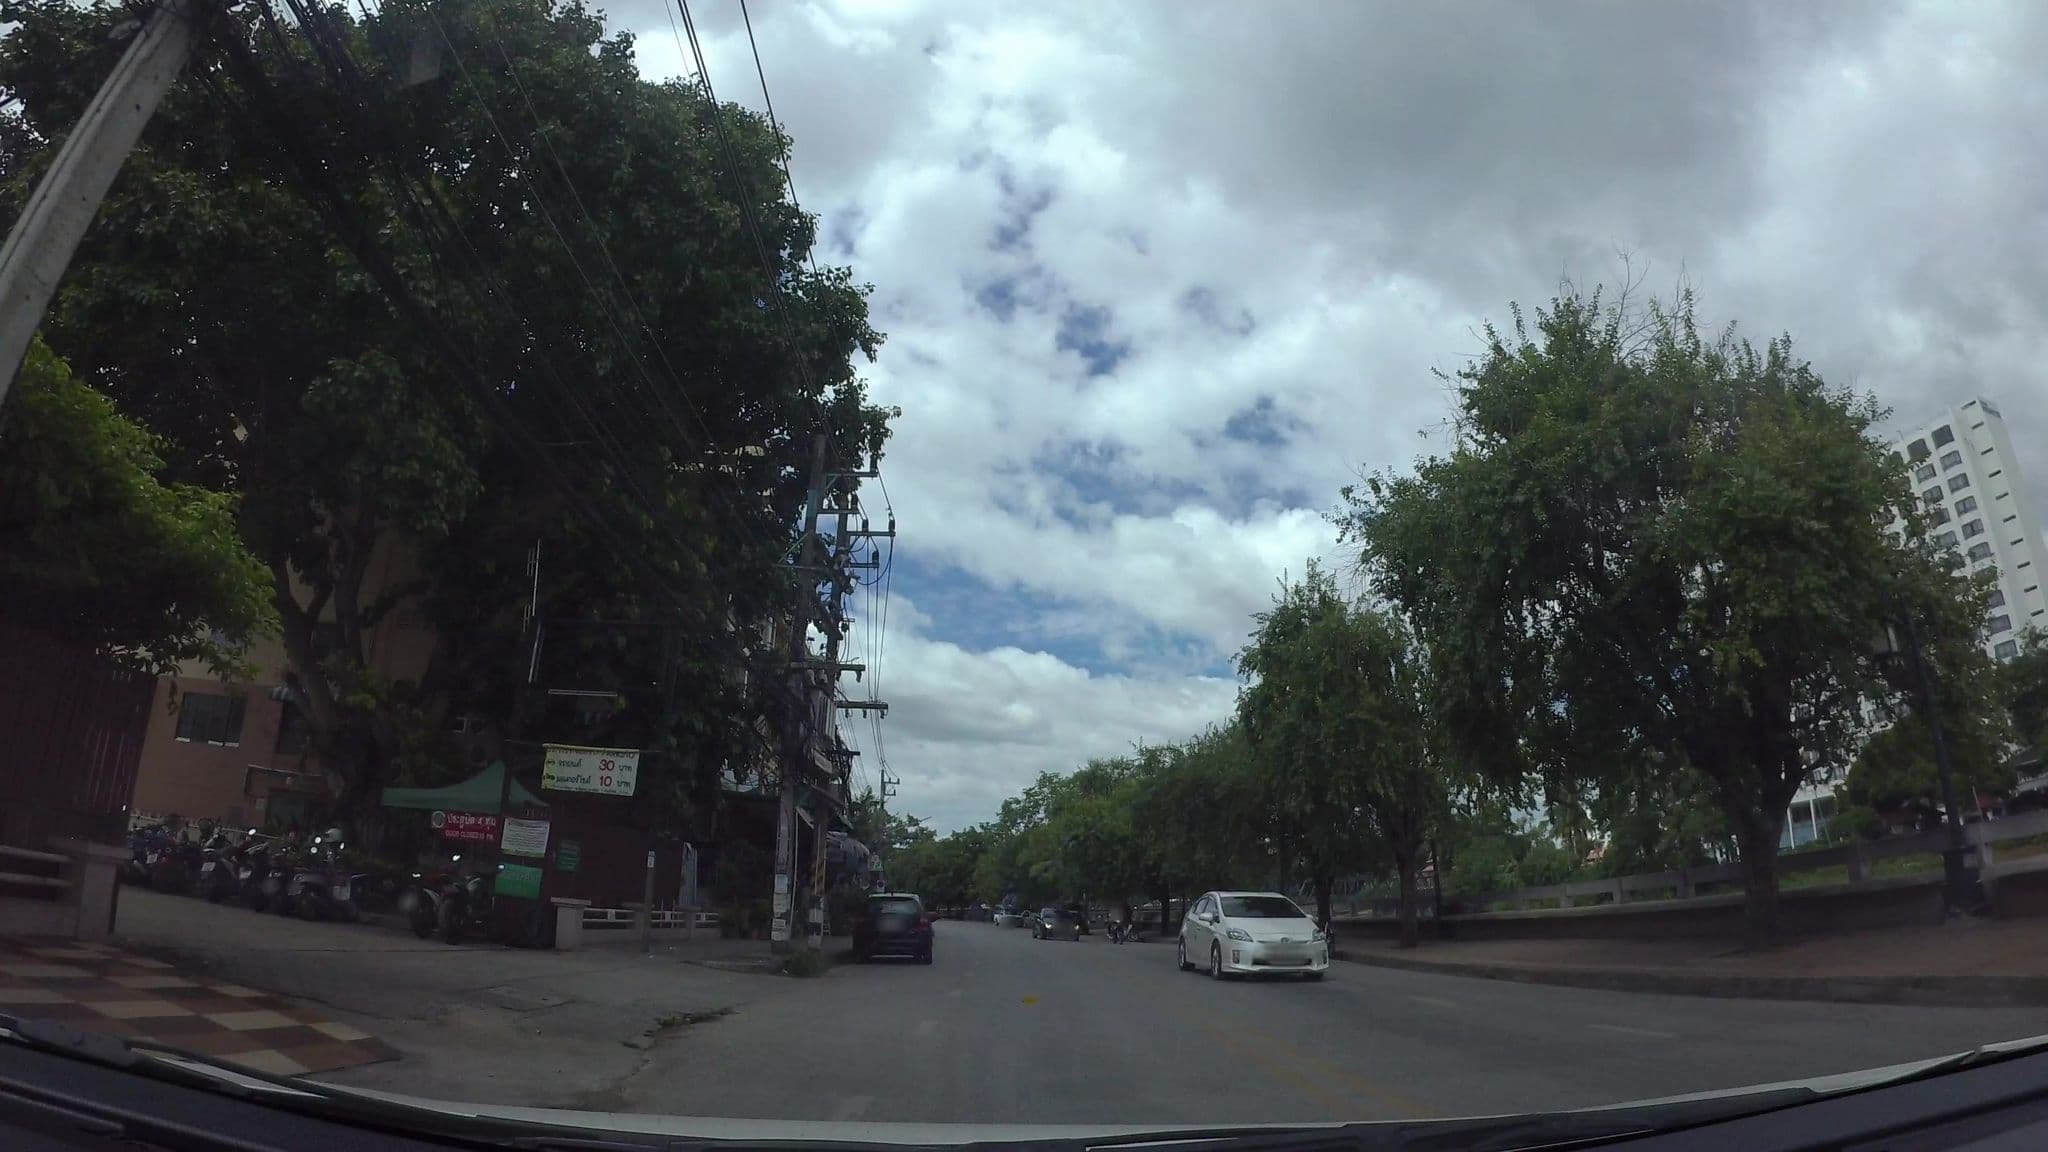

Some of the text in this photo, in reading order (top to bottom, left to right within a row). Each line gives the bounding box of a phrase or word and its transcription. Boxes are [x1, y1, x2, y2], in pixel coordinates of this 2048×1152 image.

[599, 759, 615, 772] 30
[619, 764, 632, 772] บาท
[600, 775, 612, 787] 10
[617, 780, 631, 788] บาท
